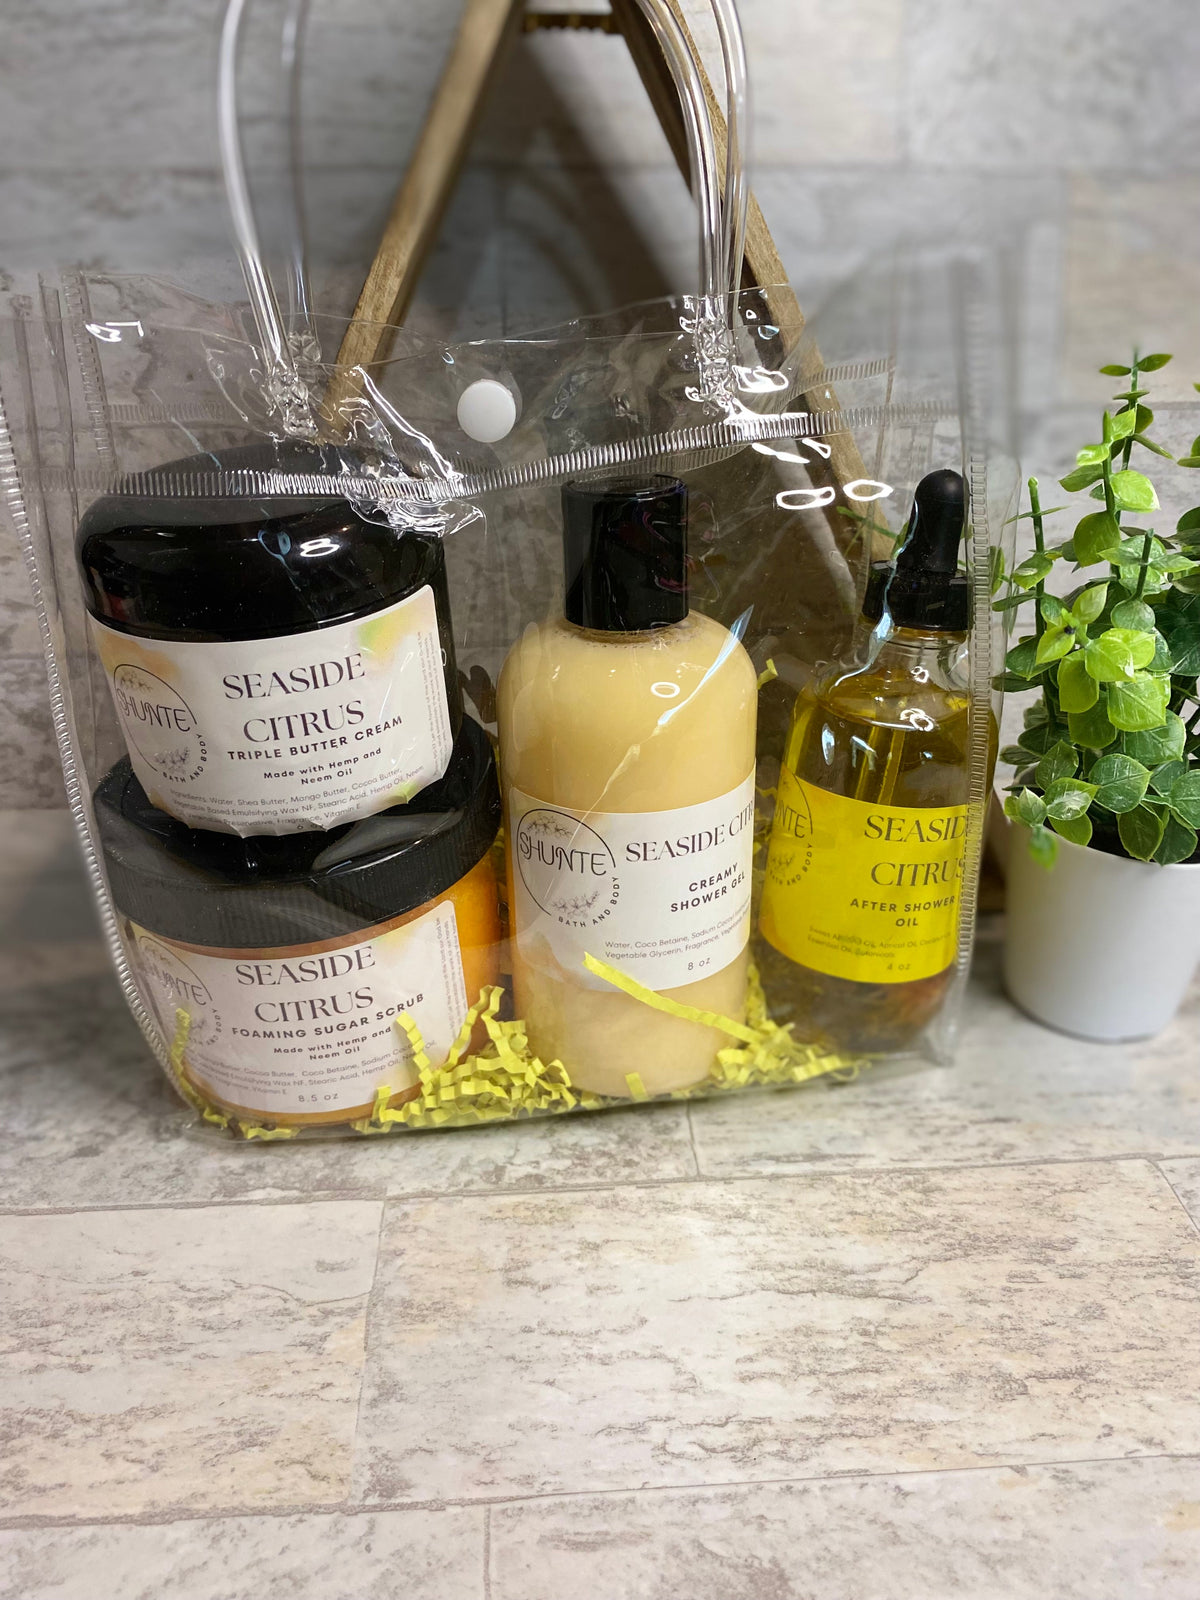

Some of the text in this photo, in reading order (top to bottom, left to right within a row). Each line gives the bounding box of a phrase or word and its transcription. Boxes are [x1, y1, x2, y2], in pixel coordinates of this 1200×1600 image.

[222, 652, 366, 700] SEASIDE
[116, 688, 190, 732] SHUNTE
[243, 700, 365, 743] CITRUS
[195, 733, 208, 762] BODY
[227, 716, 403, 761] TRIPLE BUTTER CREAM
[263, 747, 382, 780] Made with Hemp and
[301, 768, 353, 785] Neem Oil
[260, 798, 289, 806] Butter,
[290, 793, 321, 803] Mango
[323, 787, 350, 798] Butter,
[351, 778, 378, 790] Cocoa
[280, 806, 299, 814] Wax
[370, 782, 393, 795] Hemp
[324, 804, 355, 818] Vitamin
[519, 831, 607, 876] SHUNTE
[625, 824, 725, 862] SEASIDE
[689, 862, 739, 892] CREAMY
[558, 876, 620, 928] BATH AND BODY
[670, 886, 727, 912] SHOWER
[731, 873, 745, 893] GEL
[850, 896, 956, 913] AFTER SHOWER
[605, 941, 633, 949] Water,
[635, 941, 657, 949] Coco
[659, 935, 690, 946] Betaine,
[691, 925, 716, 939] Sodium
[895, 917, 919, 928] OIL
[605, 951, 647, 960] Vegetable
[649, 946, 683, 958] Glycerin,
[685, 934, 719, 951] Fragrance,
[236, 945, 376, 987] SEASIDE
[687, 957, 711, 971] 8 oz
[898, 963, 911, 971] oz
[232, 993, 425, 1039] FOAMING SUGAR SCRUB
[254, 986, 374, 1025] CITRUS
[308, 1043, 332, 1052] with
[337, 1036, 367, 1048] Hemp
[372, 1026, 392, 1038] and
[309, 1046, 360, 1061] Neem Oil
[302, 1068, 325, 1077] Coco
[326, 1063, 359, 1075] Betaine,
[361, 1052, 391, 1066] Sodium
[362, 1065, 386, 1077] Hemp
[324, 1093, 339, 1101] oz
